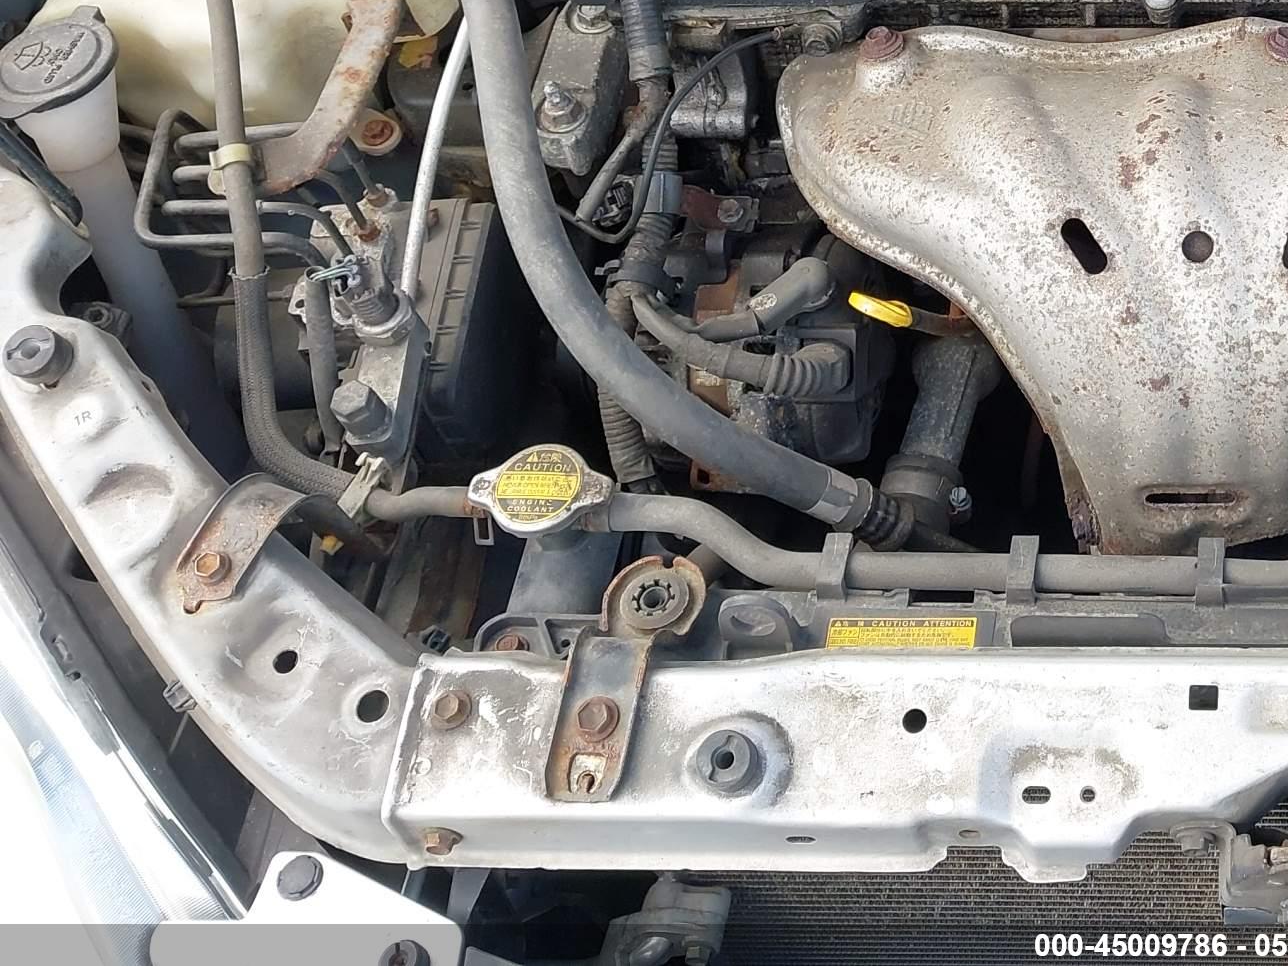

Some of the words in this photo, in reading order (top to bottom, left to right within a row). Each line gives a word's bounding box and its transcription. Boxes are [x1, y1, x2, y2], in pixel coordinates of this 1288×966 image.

[514, 462, 572, 472] CAUTION
[511, 499, 553, 507] ENGINE
[506, 505, 554, 513] COOLANT
